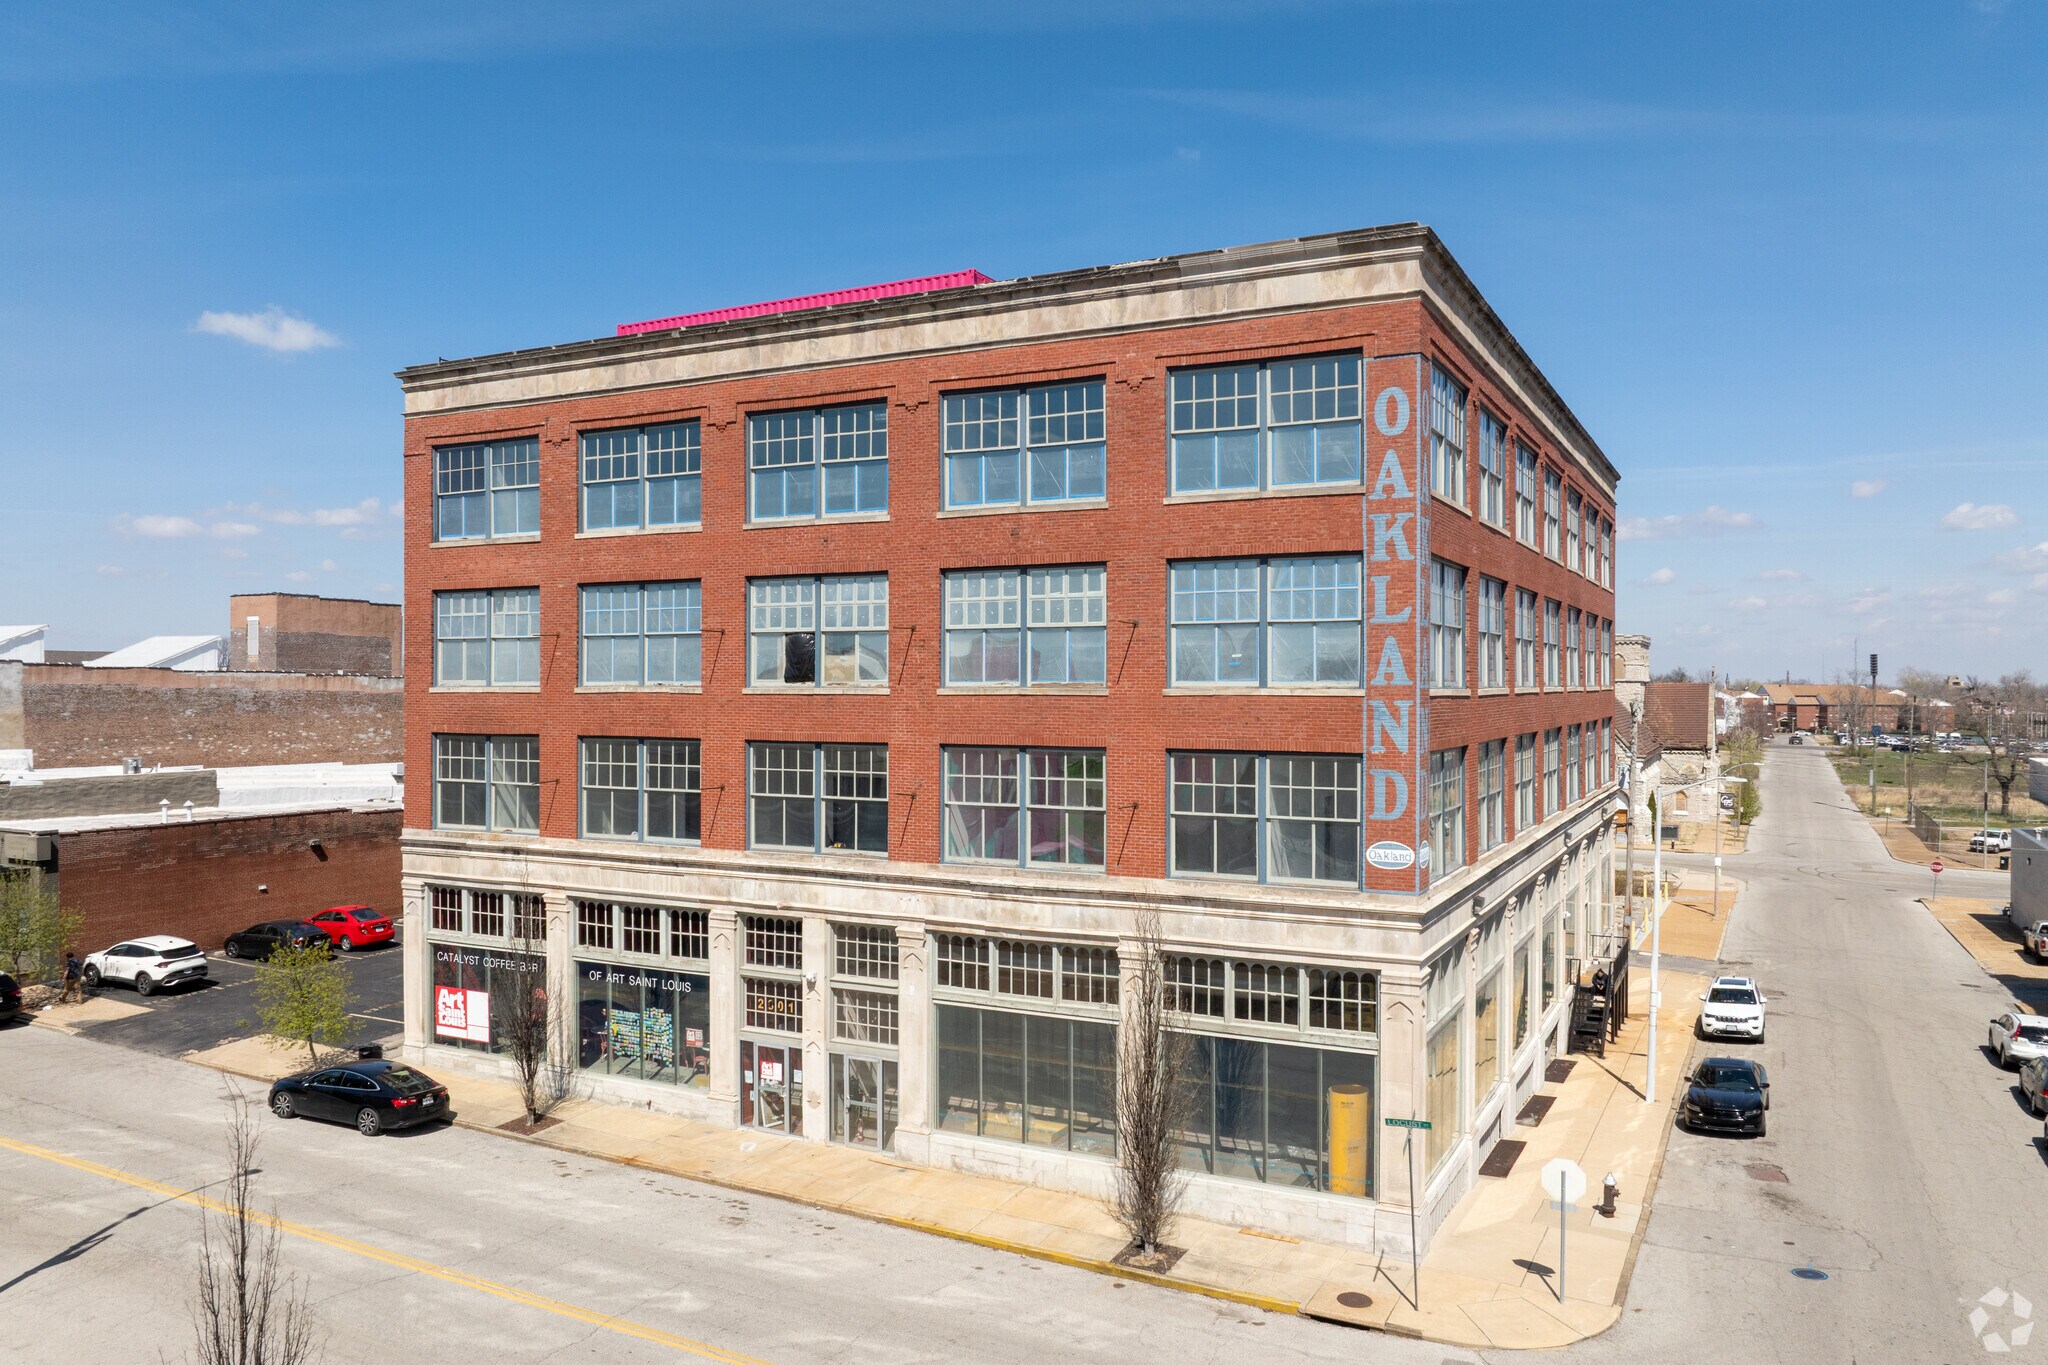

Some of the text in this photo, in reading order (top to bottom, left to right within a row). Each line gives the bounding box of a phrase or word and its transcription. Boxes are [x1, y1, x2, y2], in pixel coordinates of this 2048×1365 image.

[1368, 386, 1415, 820] OAKLAND
[1368, 849, 1412, 862] Oakland
[437, 951, 539, 973] CATALYST COFFEE BR
[589, 970, 692, 993] OF ART SAINT LOUIS
[438, 988, 464, 1010] Art
[438, 1014, 467, 1028] Louis
[1387, 1119, 1423, 1128] LOCUST
